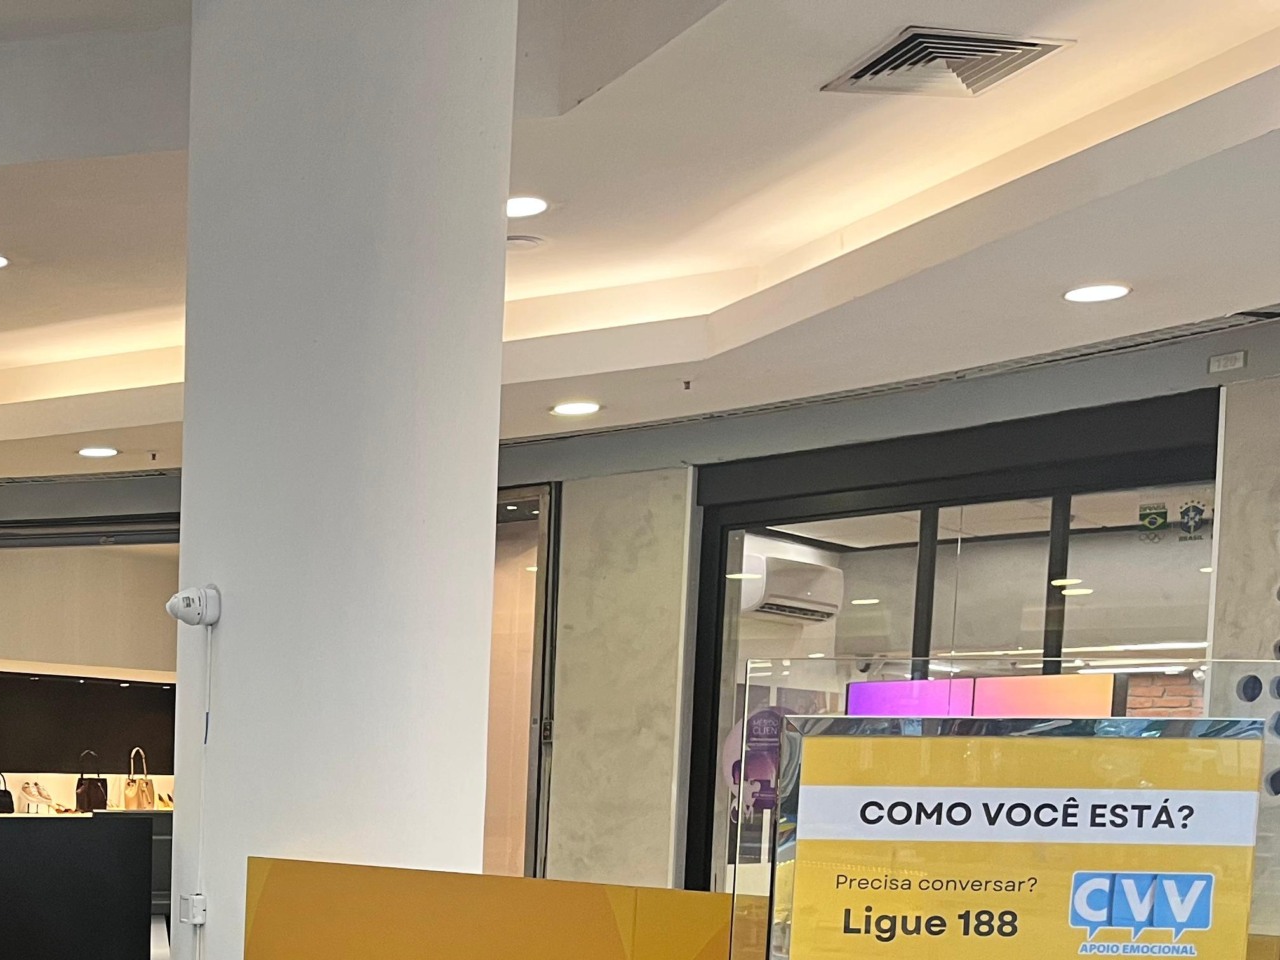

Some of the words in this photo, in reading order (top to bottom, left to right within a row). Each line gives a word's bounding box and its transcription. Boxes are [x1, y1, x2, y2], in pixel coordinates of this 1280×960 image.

[860, 801, 972, 826] COMO
[983, 798, 1079, 827] VOCÊ
[1090, 798, 1194, 829] ESTÁ?
[836, 874, 912, 891] Precisa
[918, 876, 1038, 893] conversar?
[1072, 878, 1207, 923] CVV
[843, 906, 947, 942] Ligue
[958, 910, 1018, 936] 188
[1079, 942, 1120, 954] APOIO
[1122, 944, 1196, 955] EMOCIONAL
